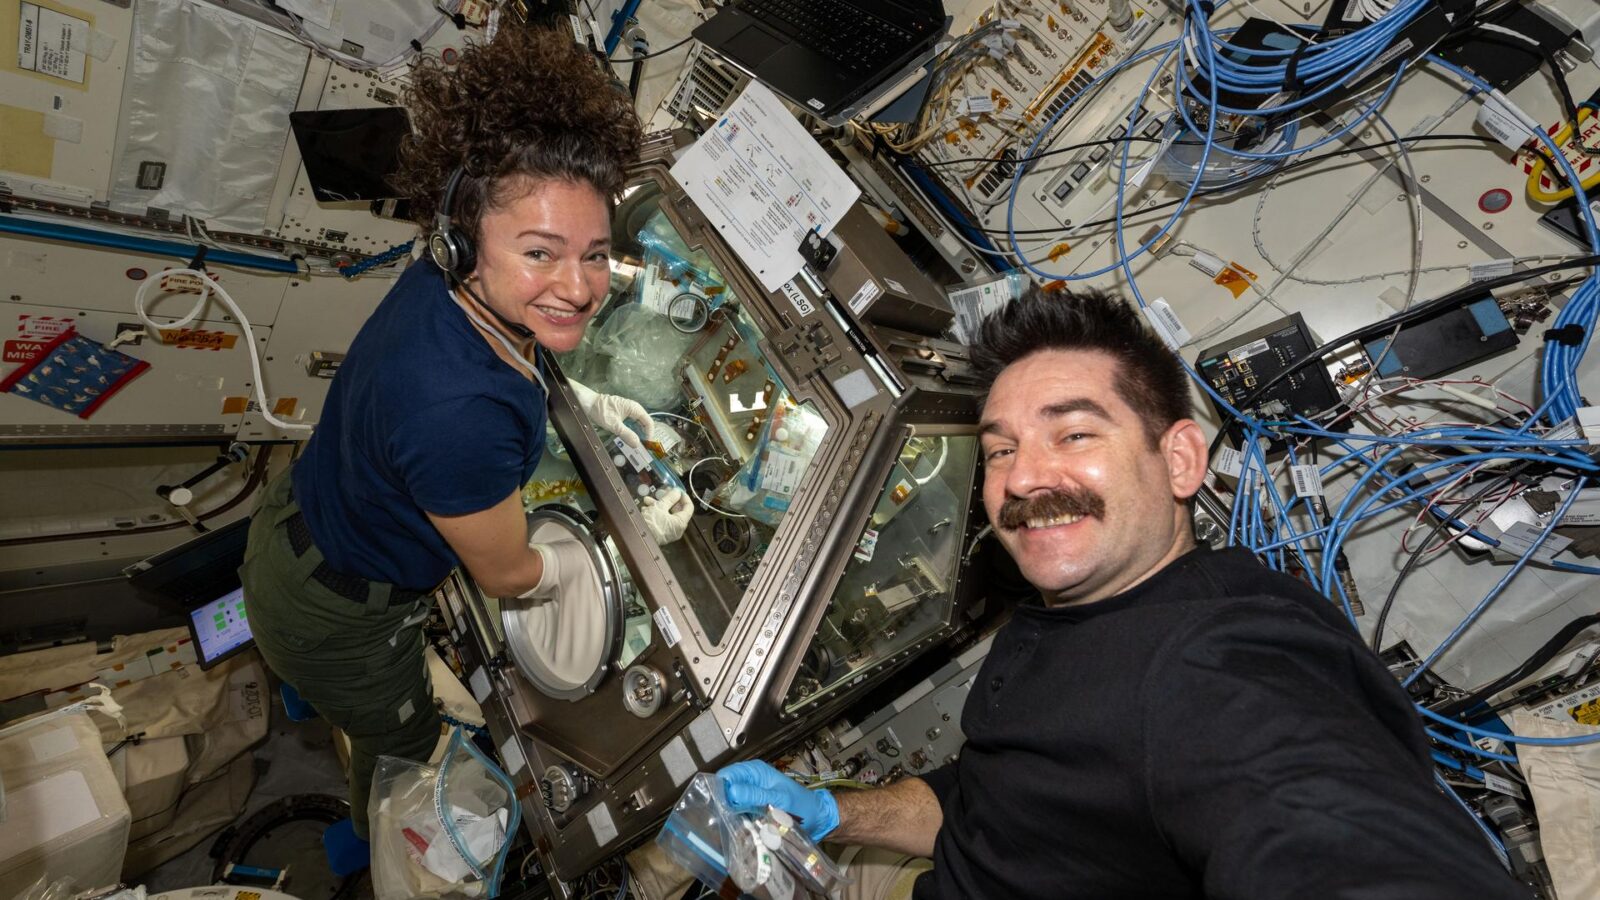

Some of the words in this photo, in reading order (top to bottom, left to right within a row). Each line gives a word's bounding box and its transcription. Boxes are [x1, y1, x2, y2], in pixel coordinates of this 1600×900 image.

[783, 283, 793, 293] ox
[790, 292, 811, 315] (LSG)
[15, 342, 42, 351] WA
[7, 351, 36, 360] MIS
